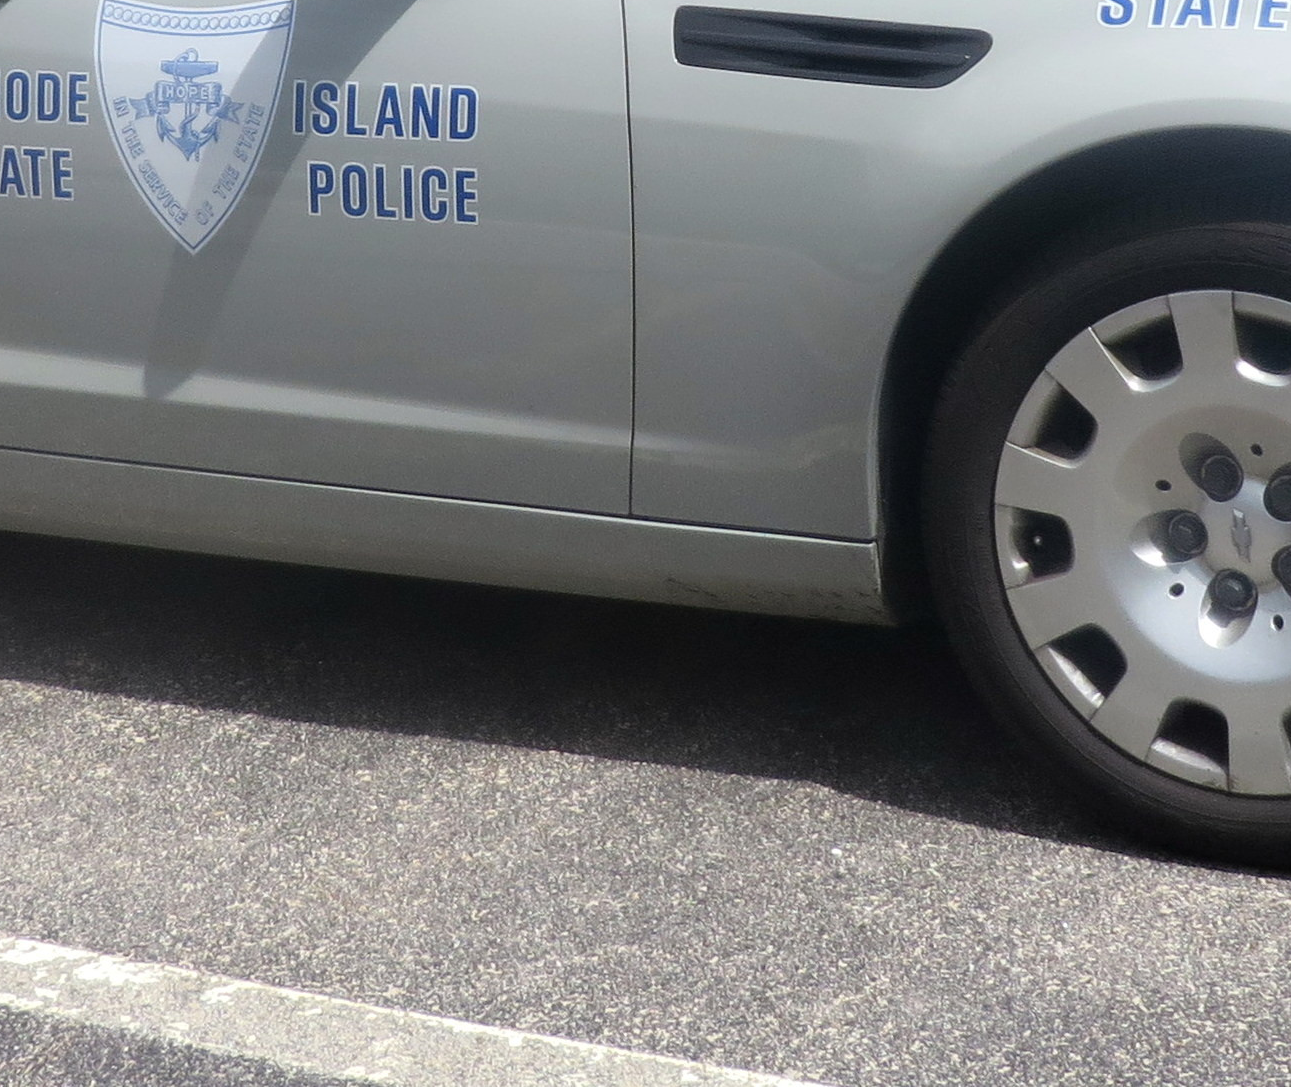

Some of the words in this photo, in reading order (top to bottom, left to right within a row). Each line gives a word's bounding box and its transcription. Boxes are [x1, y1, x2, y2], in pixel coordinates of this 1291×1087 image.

[113, 96, 130, 118] IN
[165, 85, 210, 99] HOPE
[293, 79, 479, 141] ISLAND
[121, 123, 145, 160] THE
[234, 103, 266, 163] STATE
[138, 160, 189, 226] SERVICE
[212, 165, 240, 200] THE
[308, 160, 479, 225] POLICE
[195, 200, 216, 226] OF
